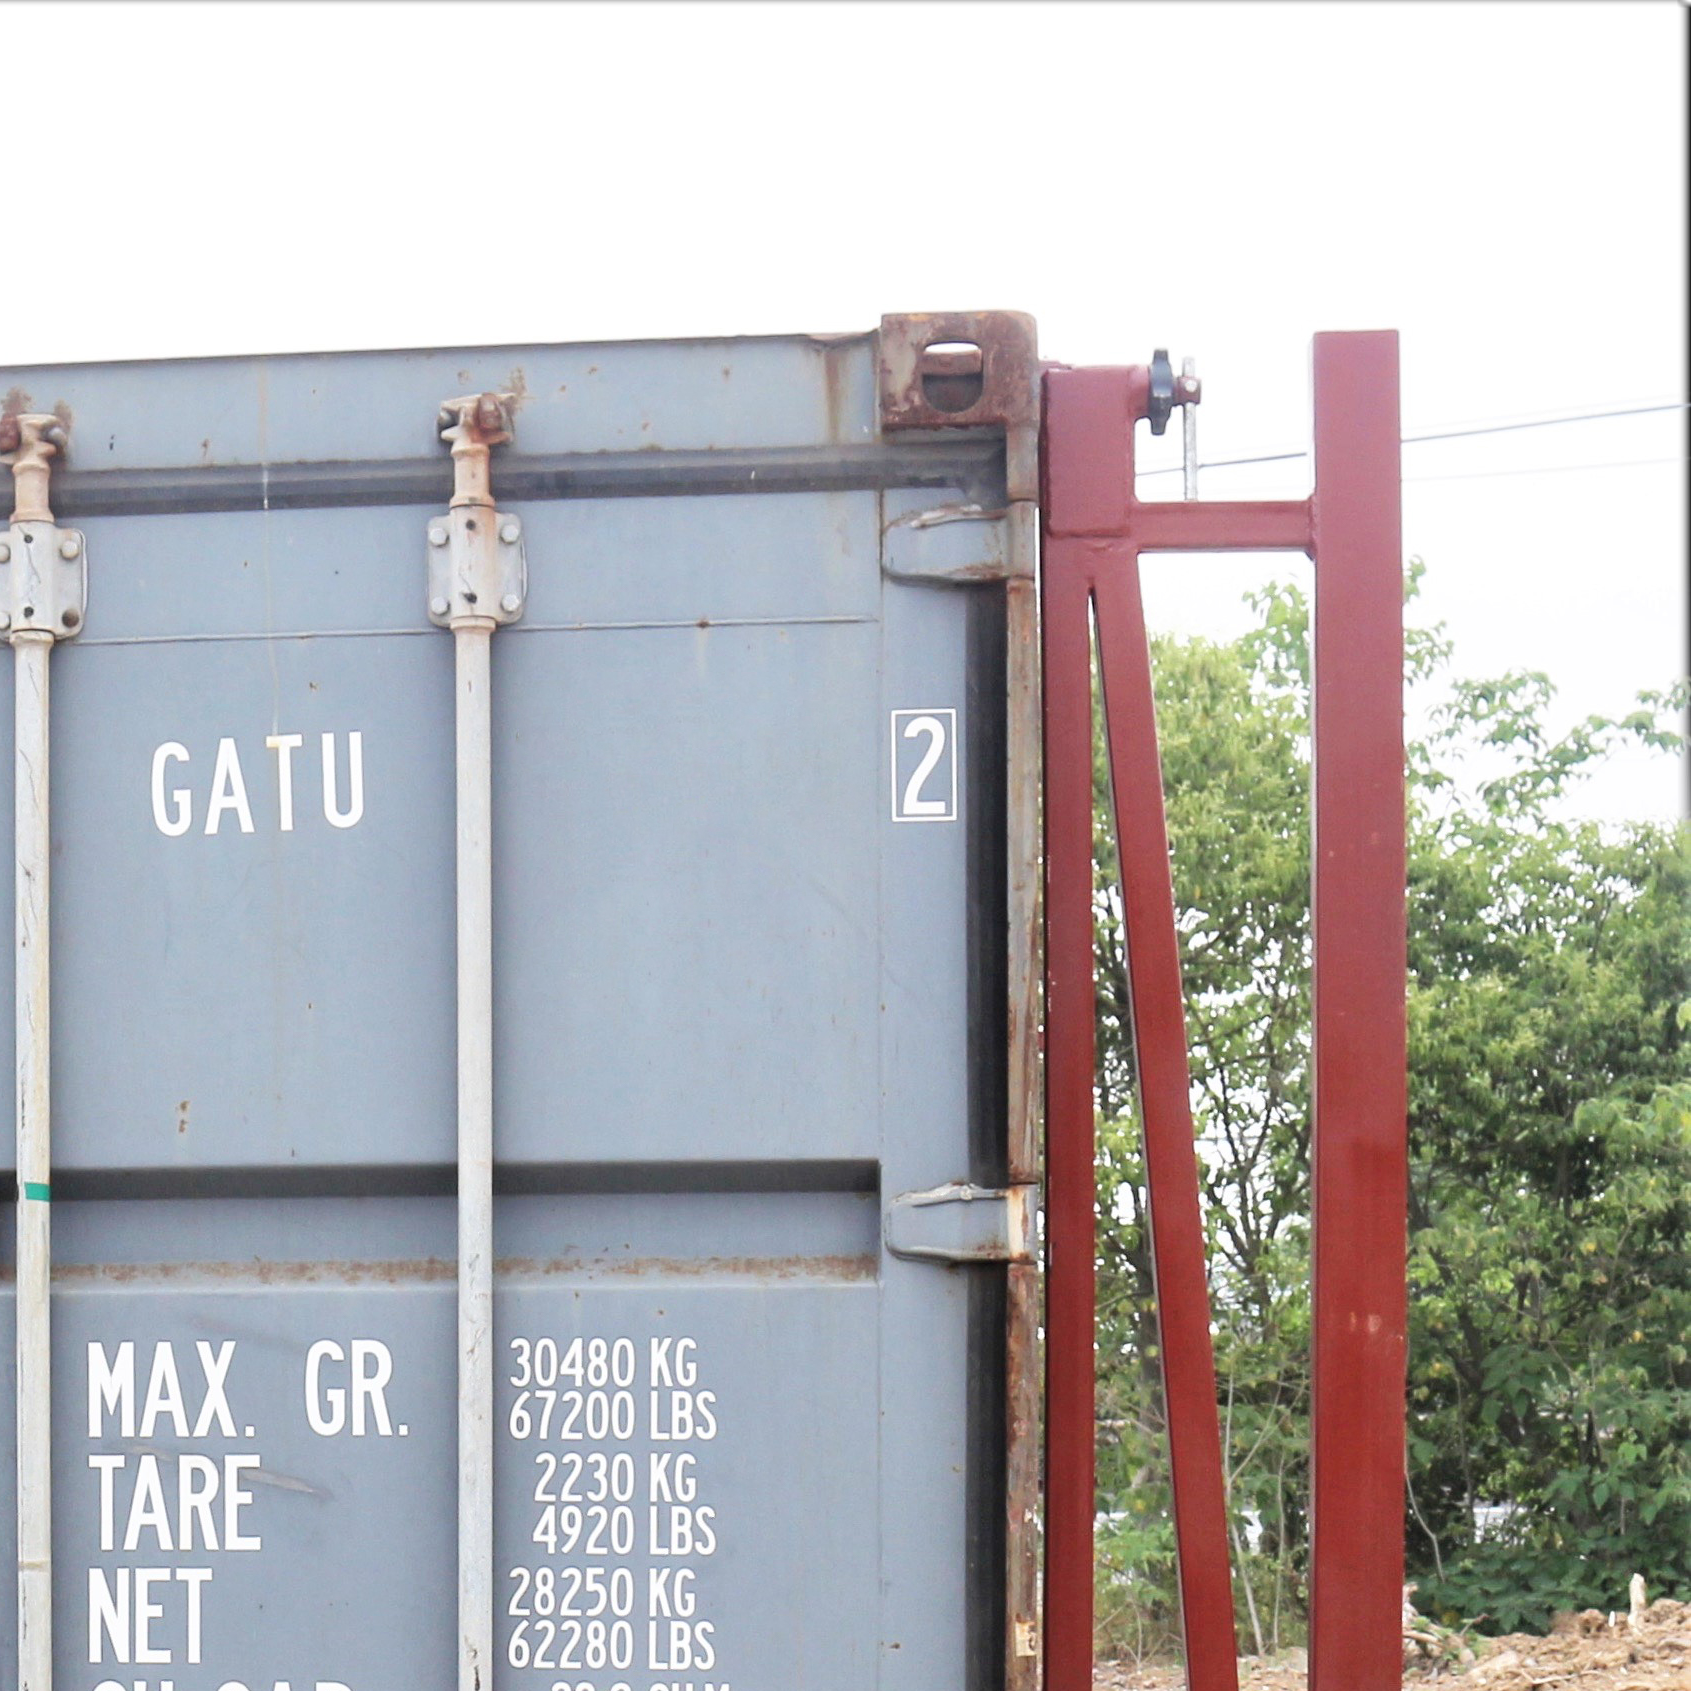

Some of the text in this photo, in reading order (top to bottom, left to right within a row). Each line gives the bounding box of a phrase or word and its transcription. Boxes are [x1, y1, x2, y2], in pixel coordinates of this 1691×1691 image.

[151, 731, 364, 837] GATU
[902, 715, 946, 815] 2
[510, 1338, 697, 1387] 30480 KG
[88, 1339, 408, 1437] MAX. GR.
[510, 1391, 717, 1440] 67200 LBS
[88, 1454, 261, 1550] TARE
[534, 1453, 696, 1502] 2230 KG
[532, 1505, 716, 1555] 4920 LBS
[89, 1568, 213, 1664] NET
[509, 1567, 696, 1617] 28250 KG
[508, 1620, 715, 1670] 62280 LBS
